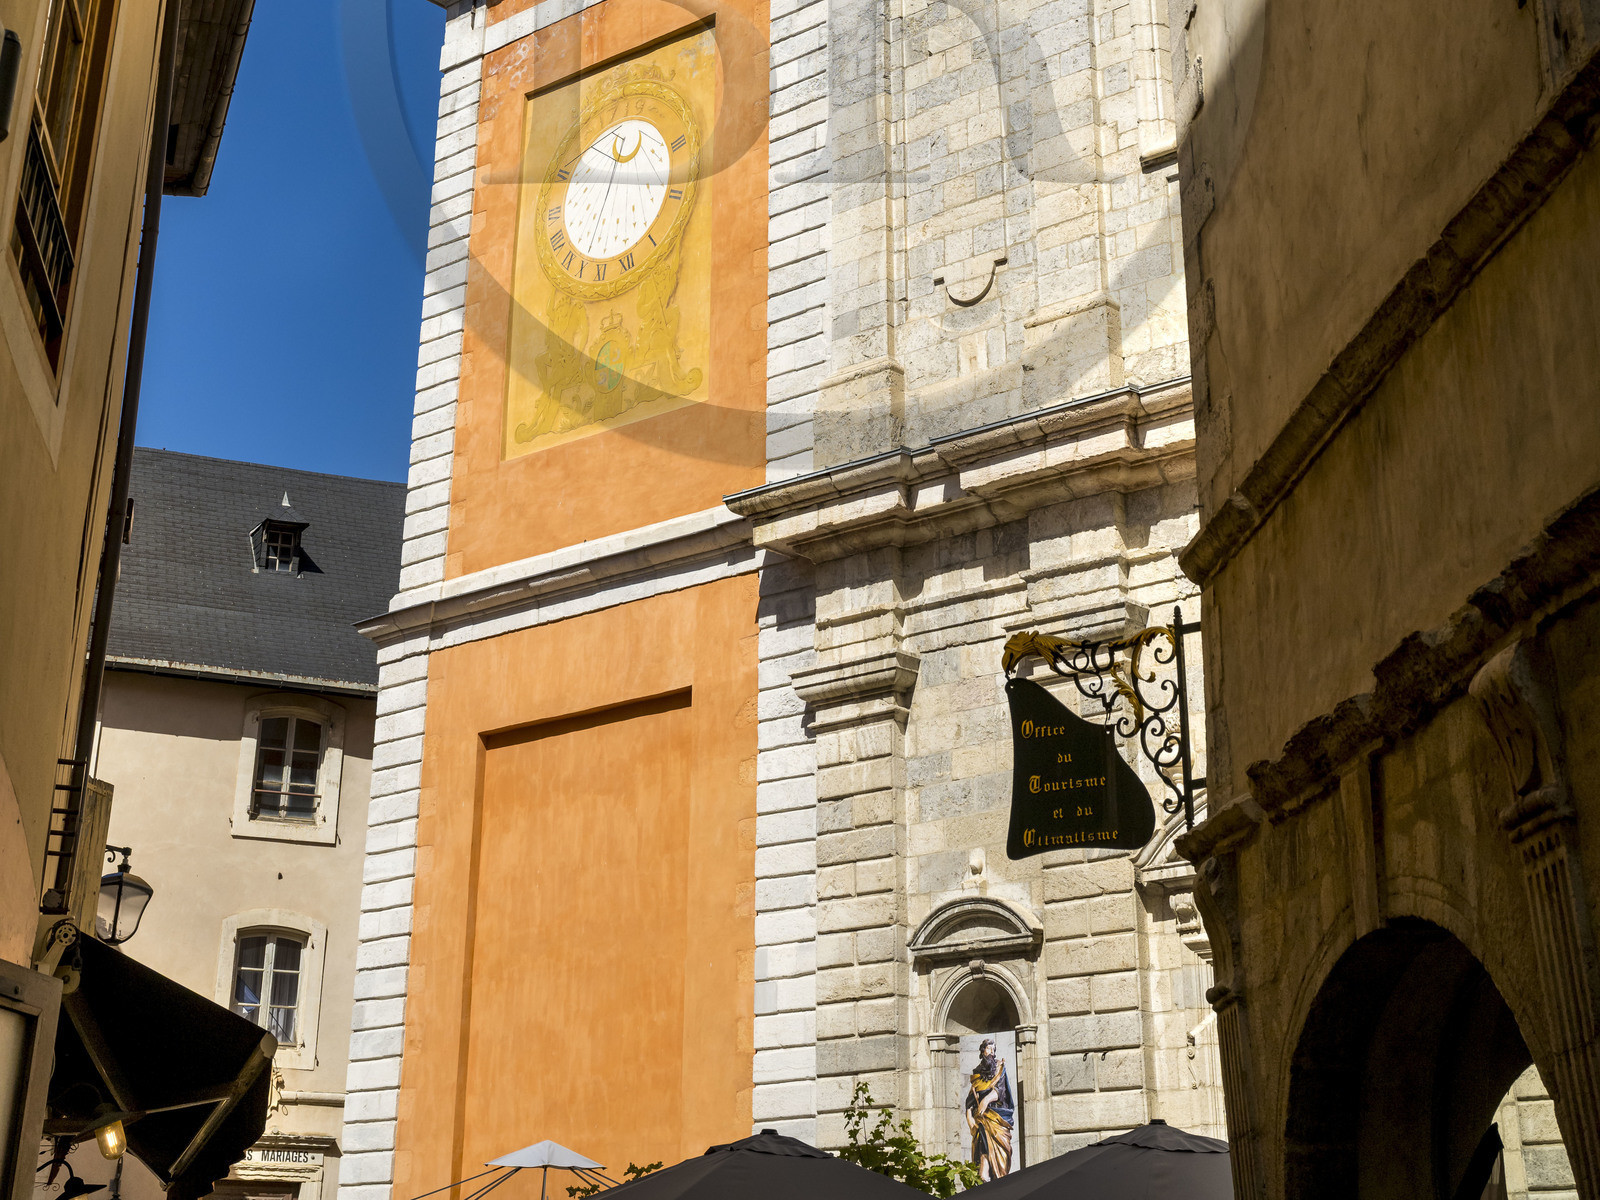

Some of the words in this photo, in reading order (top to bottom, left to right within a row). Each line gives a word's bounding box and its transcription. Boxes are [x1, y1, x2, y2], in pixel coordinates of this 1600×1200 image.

[670, 134, 687, 153] III
[668, 188, 683, 201] II
[574, 260, 589, 279] X
[592, 263, 608, 282] XI
[618, 252, 635, 275] XII
[1021, 719, 1066, 739] Office
[1057, 753, 1073, 763] du
[1029, 775, 1106, 794] Tourisme
[1053, 808, 1064, 819] et
[1076, 806, 1093, 817] du
[261, 1150, 309, 1163] MARIAGES
